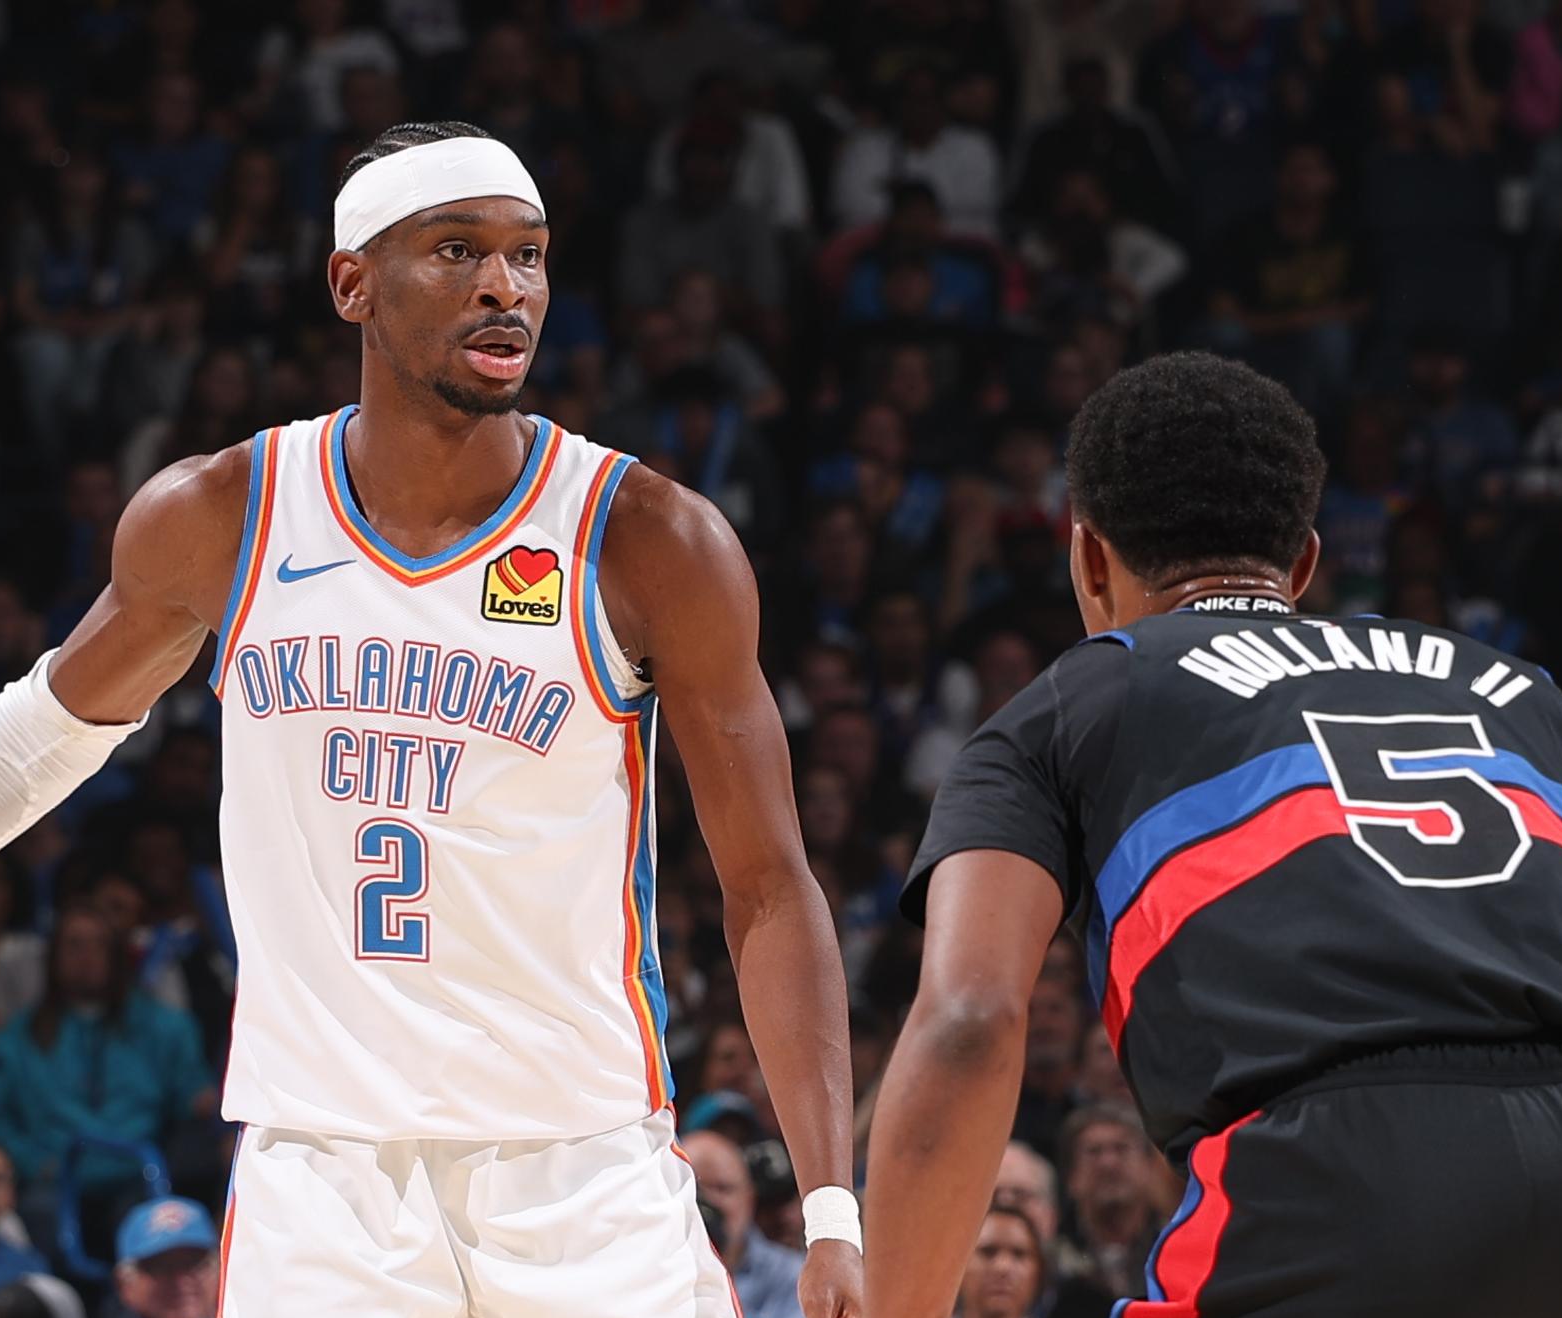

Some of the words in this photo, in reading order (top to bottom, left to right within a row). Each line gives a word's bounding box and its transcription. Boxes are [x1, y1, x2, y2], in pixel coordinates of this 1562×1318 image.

[1194, 597, 1250, 612] NIKE
[235, 635, 575, 757] OKLAHOMA
[1178, 626, 1455, 699] HOLLAND
[1470, 661, 1533, 707] II
[321, 726, 466, 814] CITY
[1302, 710, 1532, 888] 5
[355, 817, 430, 963] 2
